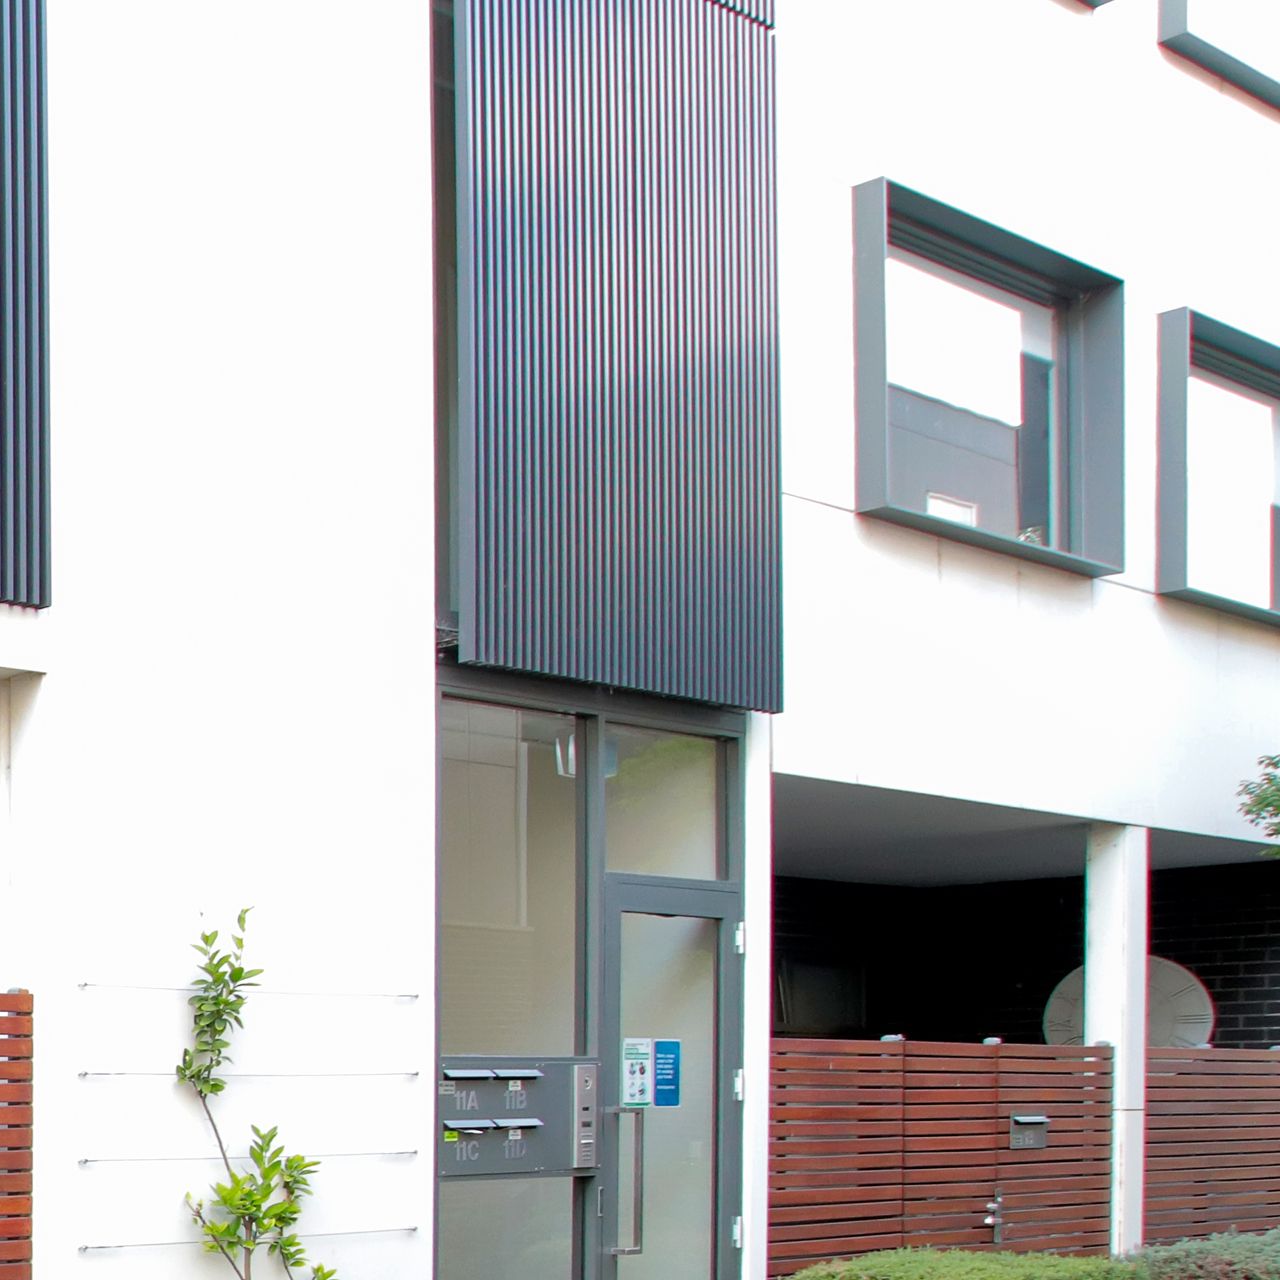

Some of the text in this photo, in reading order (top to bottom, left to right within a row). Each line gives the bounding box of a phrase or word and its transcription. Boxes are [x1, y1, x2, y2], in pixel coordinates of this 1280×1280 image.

[454, 1090, 479, 1110] 11A
[504, 1090, 527, 1109] 11B
[454, 1141, 479, 1160] 11C
